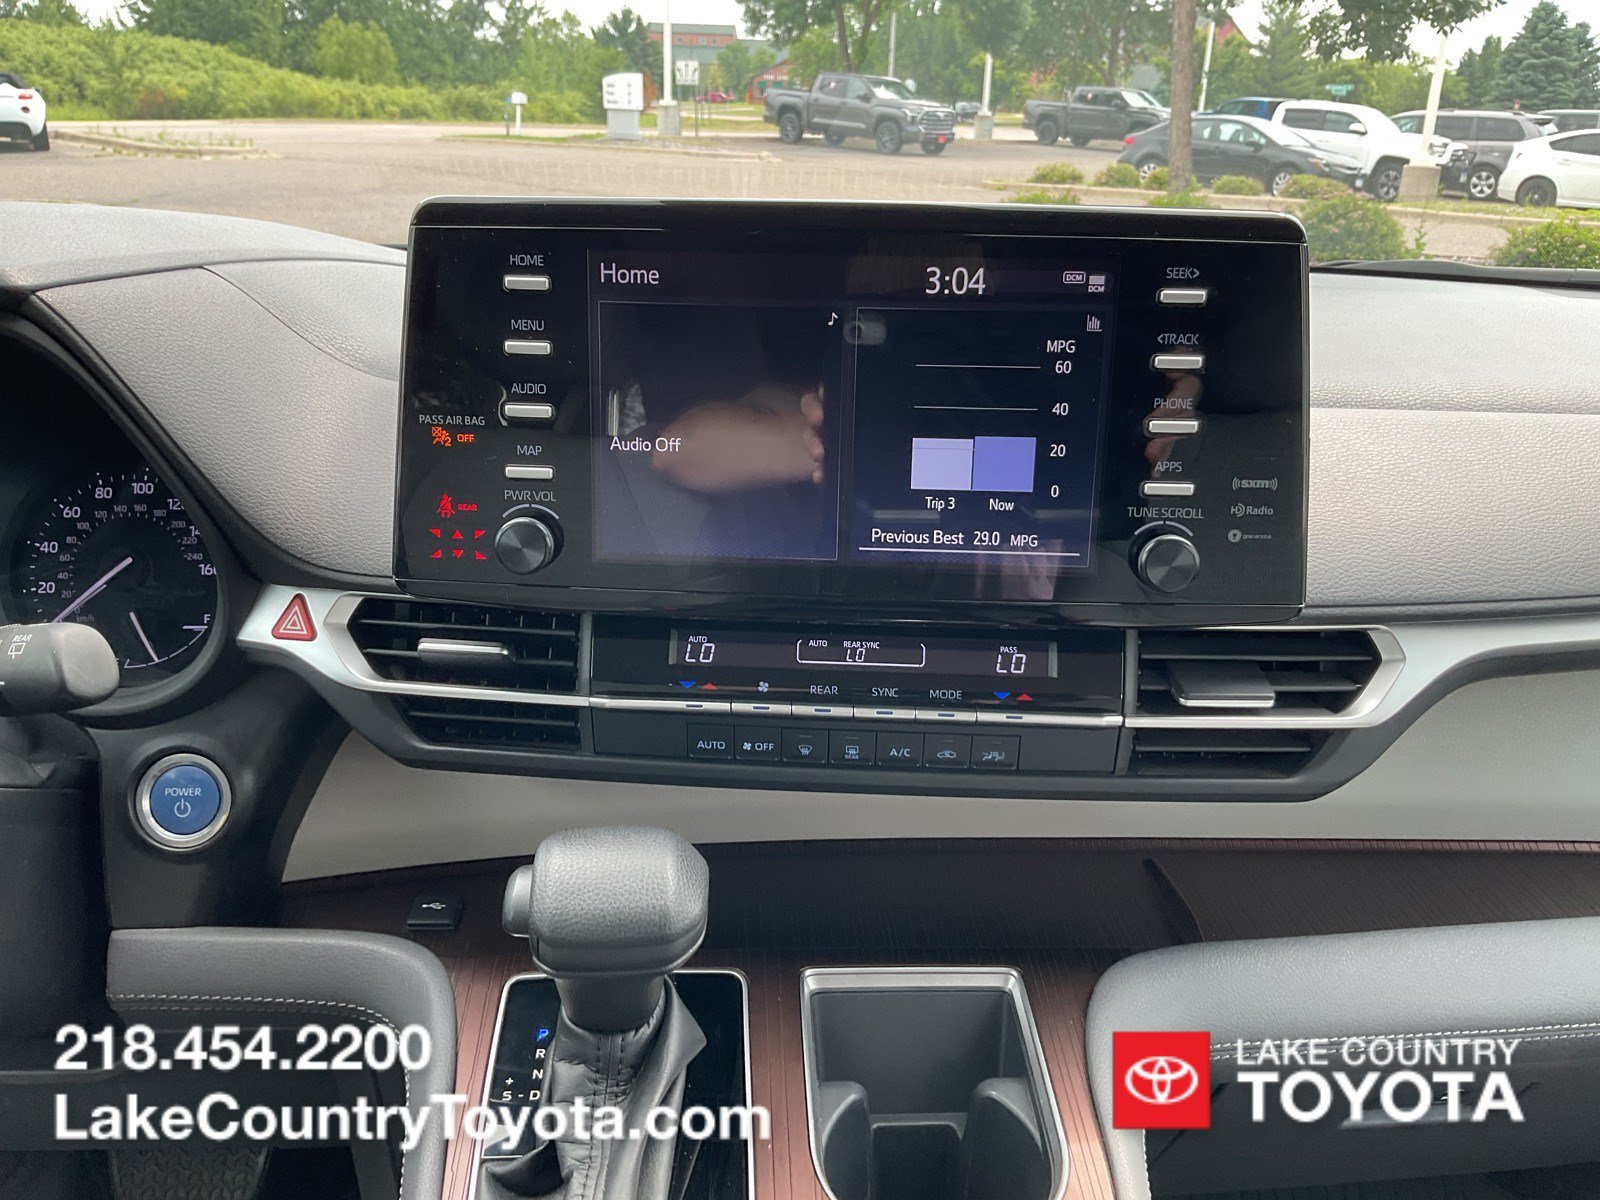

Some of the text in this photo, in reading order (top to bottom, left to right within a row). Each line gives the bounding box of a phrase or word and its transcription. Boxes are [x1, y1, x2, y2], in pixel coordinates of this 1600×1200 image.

[509, 254, 544, 266] HOME
[600, 262, 660, 285] Home
[1066, 273, 1083, 282] DCM
[925, 266, 986, 295] 3:04
[1088, 284, 1105, 293] DCM
[511, 319, 545, 331] MENU
[1046, 340, 1076, 354] MPG
[1055, 360, 1072, 374] 60
[511, 383, 547, 395] AUDIO
[1051, 402, 1069, 416] 40
[1153, 397, 1193, 410] PHONE
[419, 414, 485, 426] PASS AIR BAG
[457, 433, 474, 443] OFF
[516, 445, 542, 456] MAP
[610, 436, 682, 453] Audio Off
[1050, 444, 1066, 457] 20
[1154, 461, 1183, 472] APPS
[95, 487, 113, 499] 80
[131, 482, 154, 495] 100
[1050, 485, 1060, 498] 0
[504, 489, 556, 502] PWR VOL
[167, 499, 185, 510] 12
[457, 503, 478, 512] REAR
[925, 496, 956, 512] Trip 3
[989, 498, 1014, 511] Now
[63, 506, 81, 519] 60
[1127, 506, 1204, 519] TUNE SCROLL
[1246, 505, 1274, 516] Radio
[871, 528, 1038, 547] Previous Best 29.0 MPG
[40, 541, 58, 553] 40
[38, 581, 56, 594] 20
[203, 614, 211, 623] F
[12, 634, 33, 642] REAR
[688, 635, 708, 643] AUTO
[808, 639, 828, 647] AUTO
[843, 640, 880, 649] REAR SYNC
[810, 685, 839, 695] REAR
[871, 687, 899, 697] SYNC
[929, 689, 963, 699] MODE
[697, 740, 726, 749] AUTO
[754, 742, 775, 751] OFF
[889, 748, 911, 757] A/C
[165, 787, 201, 797] POWER
[537, 1028, 549, 1042] P
[535, 1049, 546, 1059] R
[533, 1069, 543, 1079] N
